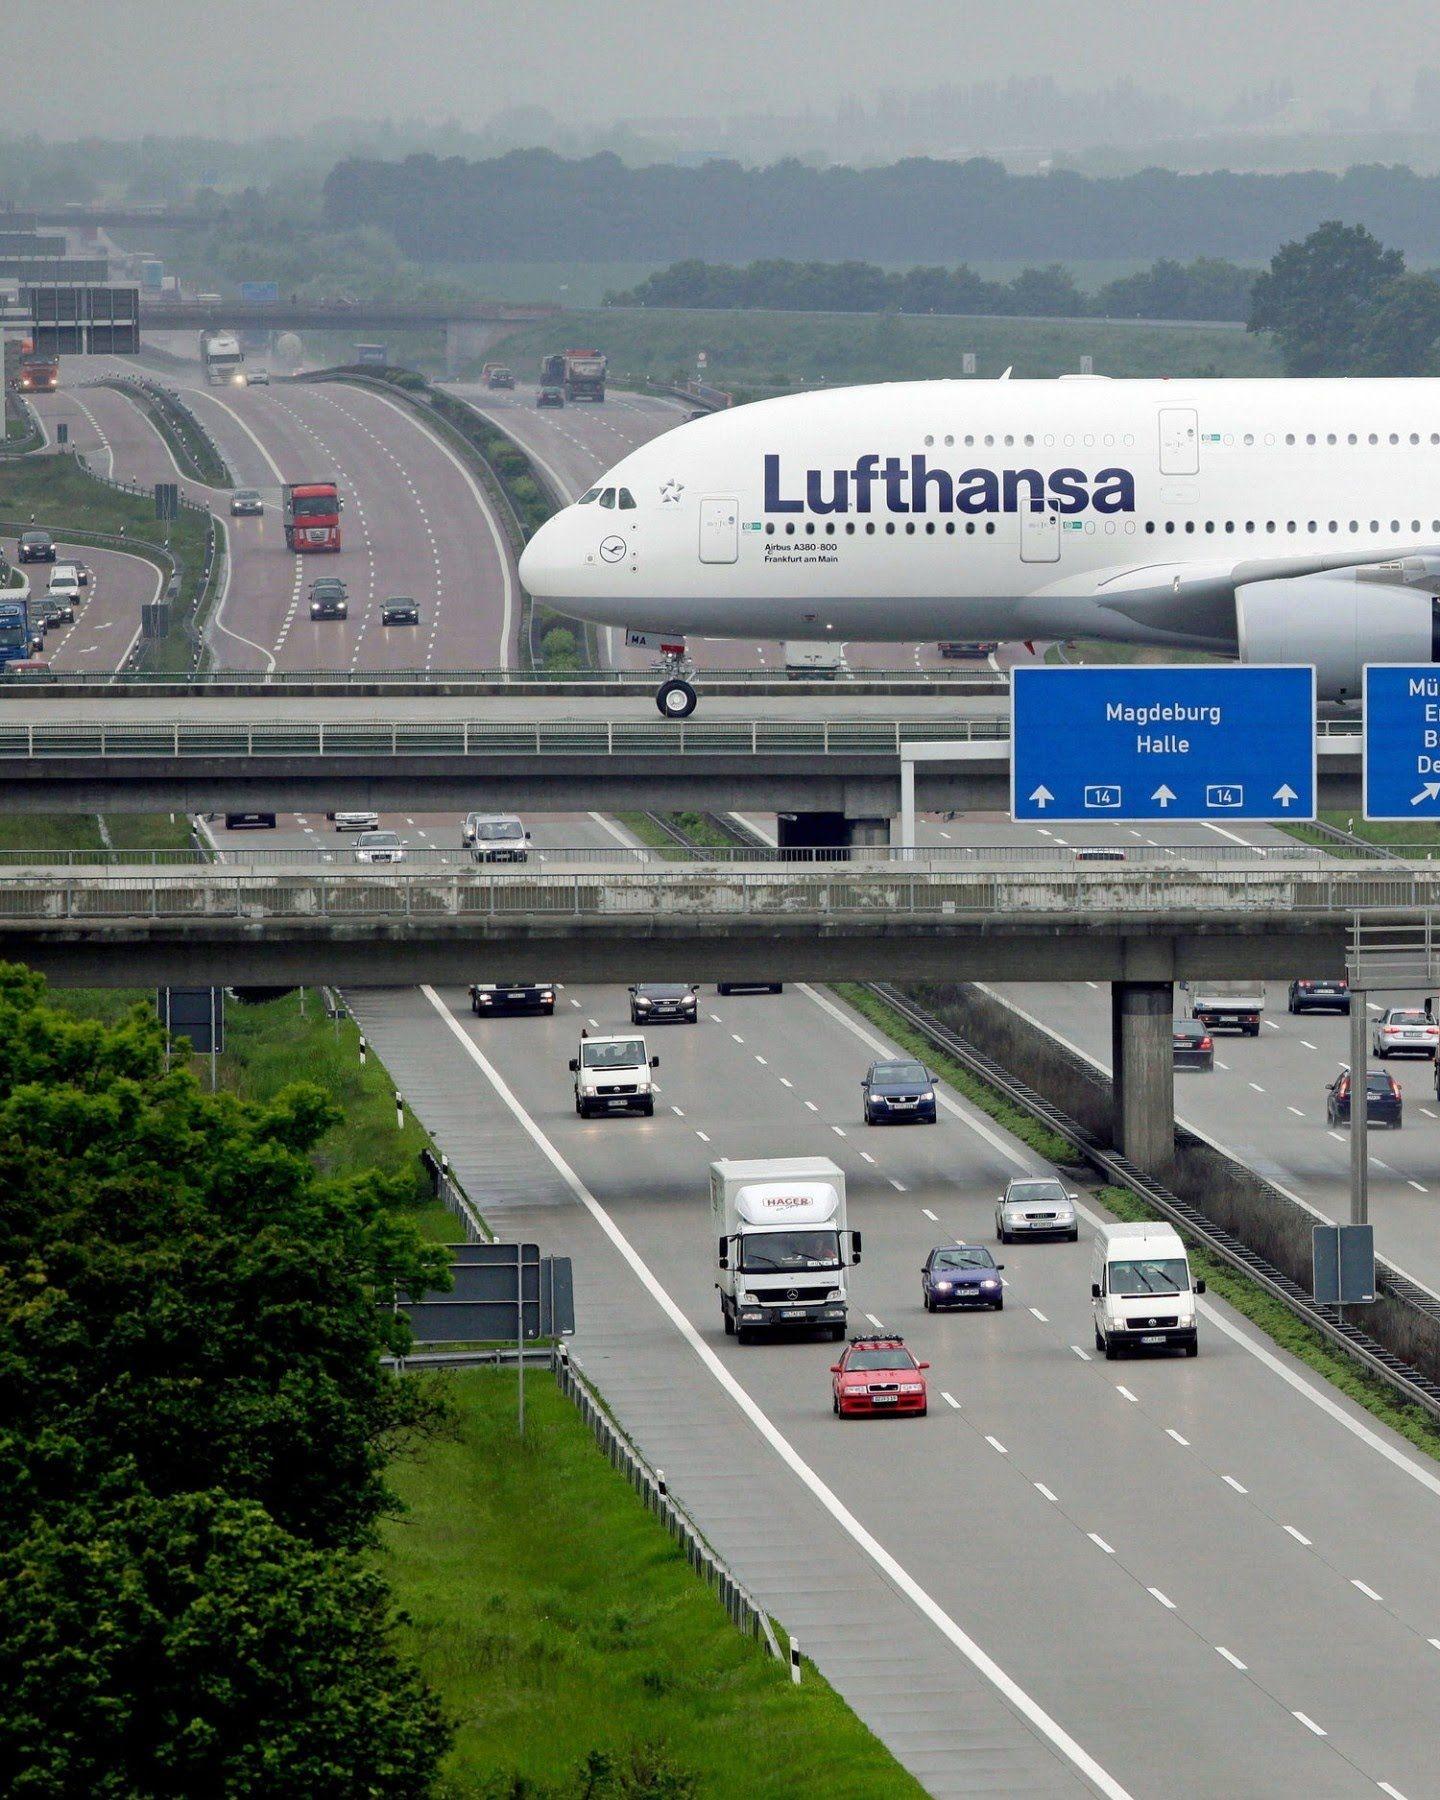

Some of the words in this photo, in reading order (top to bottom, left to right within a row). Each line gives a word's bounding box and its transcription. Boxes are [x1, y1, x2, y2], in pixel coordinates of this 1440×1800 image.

[765, 454, 1135, 514] Lufthansa
[765, 543, 791, 551] Airbus
[793, 543, 838, 551] A380-800
[764, 555, 802, 563] Frankfurt
[818, 555, 838, 563] Main
[631, 635, 646, 645] MA
[1106, 702, 1221, 725] Magdeburg
[1137, 735, 1189, 753] Halle
[1094, 788, 1110, 804] 14
[1216, 788, 1233, 804] 14
[767, 1197, 808, 1206] HAGER
